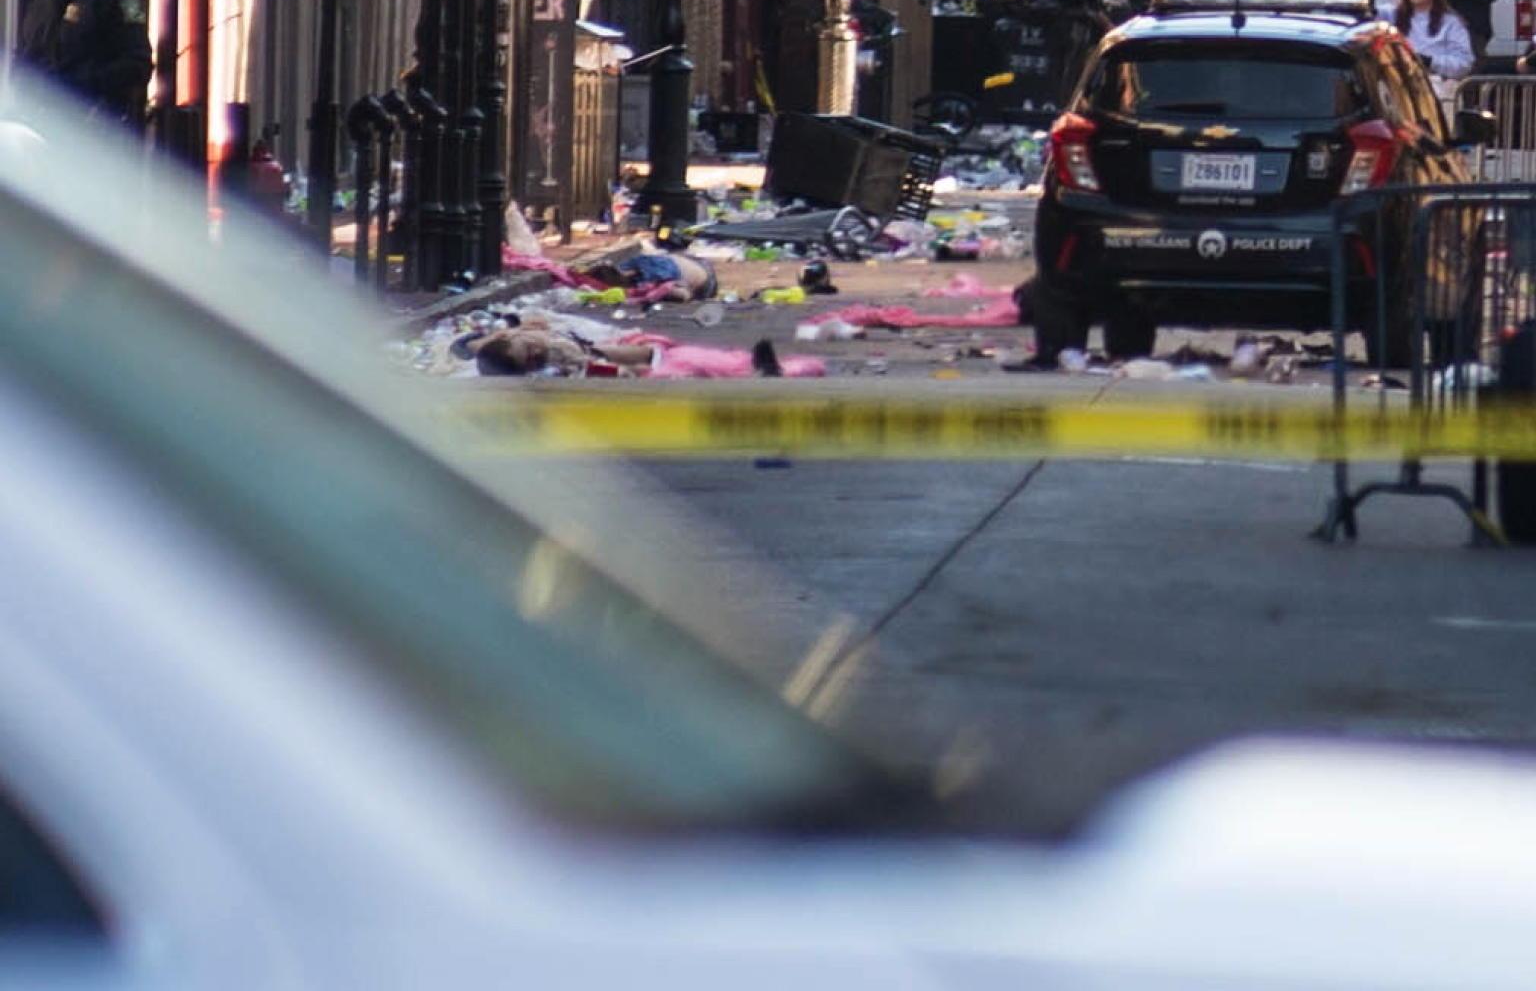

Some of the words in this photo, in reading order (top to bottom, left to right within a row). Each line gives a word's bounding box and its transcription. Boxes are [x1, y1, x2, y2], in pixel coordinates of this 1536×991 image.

[1136, 237, 1192, 249] ORLEANS
[1232, 237, 1276, 250] POLICE
[1278, 237, 1313, 250] DEPT
